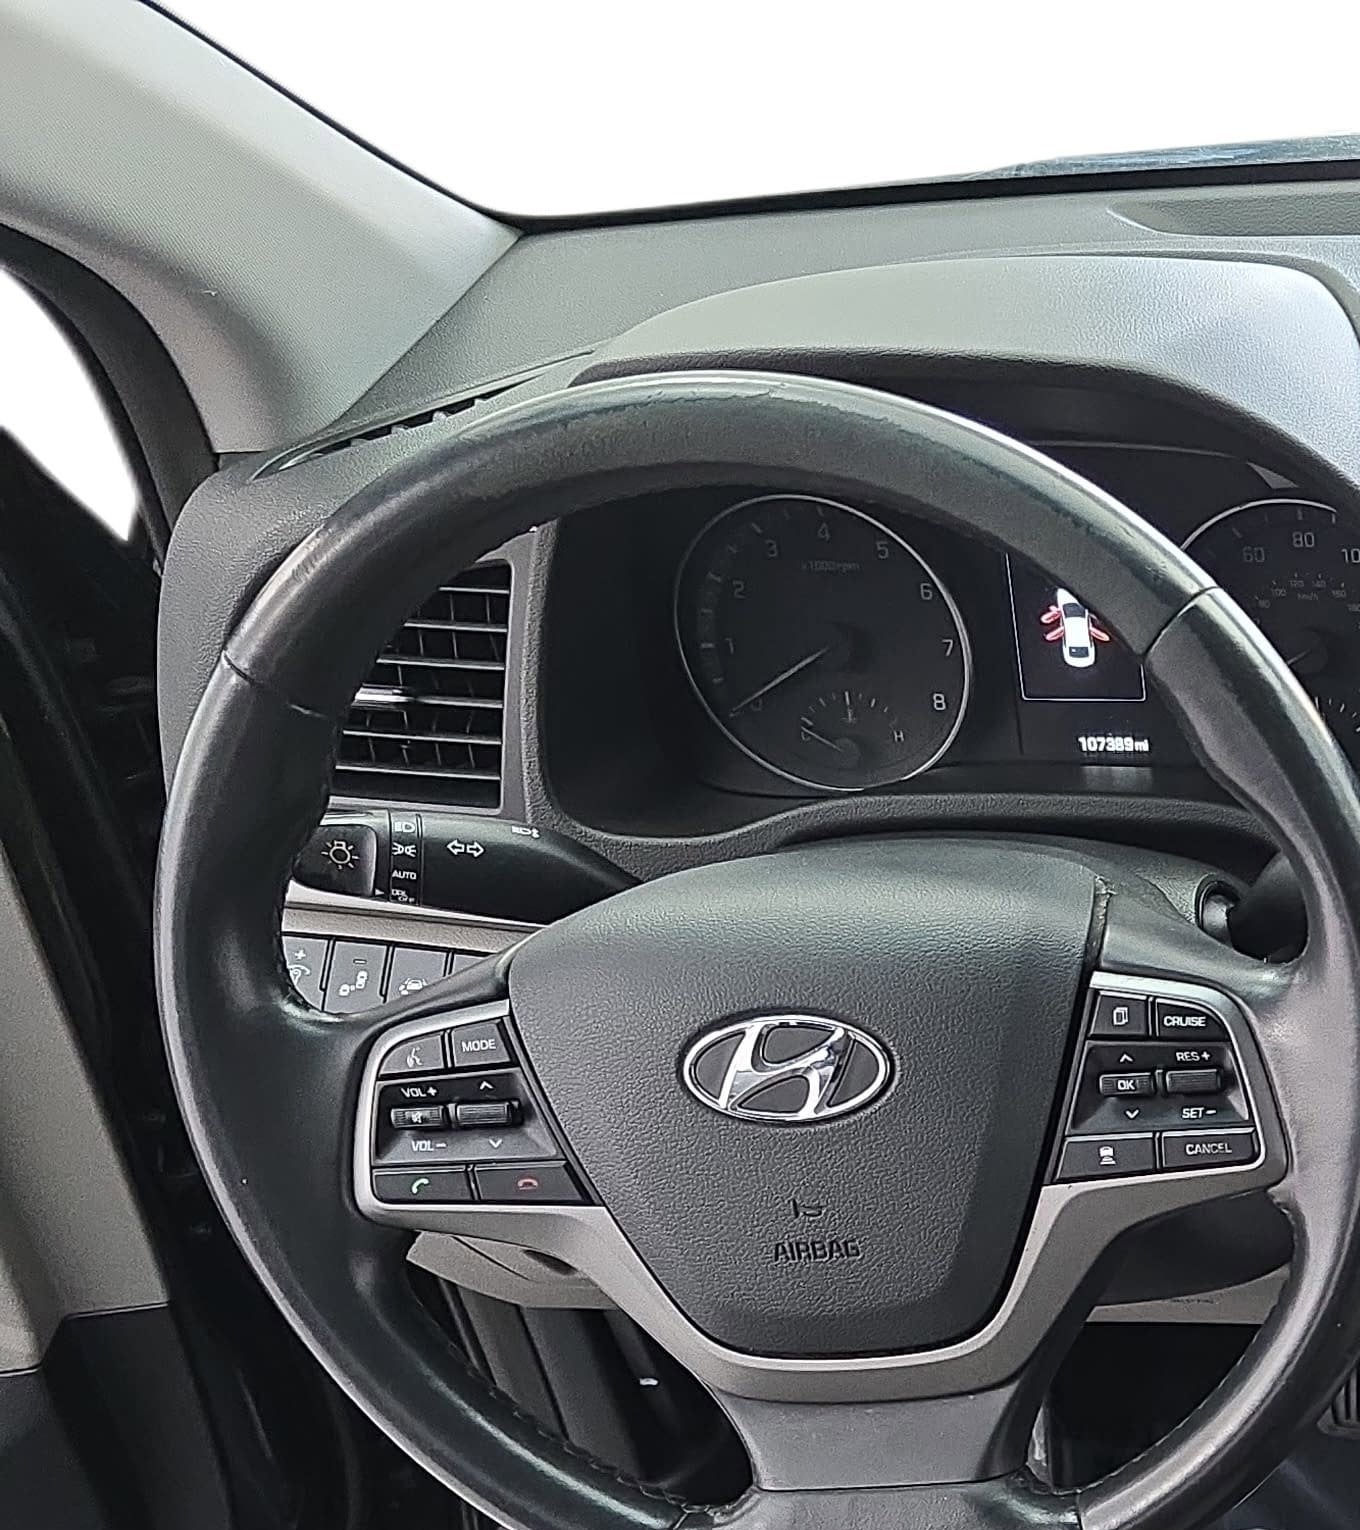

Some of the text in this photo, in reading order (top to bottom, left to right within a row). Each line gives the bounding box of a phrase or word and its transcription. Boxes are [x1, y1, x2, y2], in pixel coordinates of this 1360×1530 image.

[817, 523, 830, 541] 4
[1292, 532, 1315, 547] 80
[767, 540, 777, 557] 3
[876, 541, 889, 559] 5
[1243, 547, 1265, 562] 60
[733, 580, 745, 599] 2
[920, 582, 932, 600] 6
[725, 638, 734, 653] 1
[942, 639, 953, 656] 7
[933, 693, 946, 711] 8
[894, 731, 904, 742] H
[392, 869, 417, 880] AUTO
[1163, 1015, 1206, 1027] CRUISE
[461, 1038, 496, 1052] MODE
[1117, 1079, 1135, 1090] OK
[1186, 1143, 1232, 1155] CANCEL
[774, 1239, 861, 1262] AIRBAG
